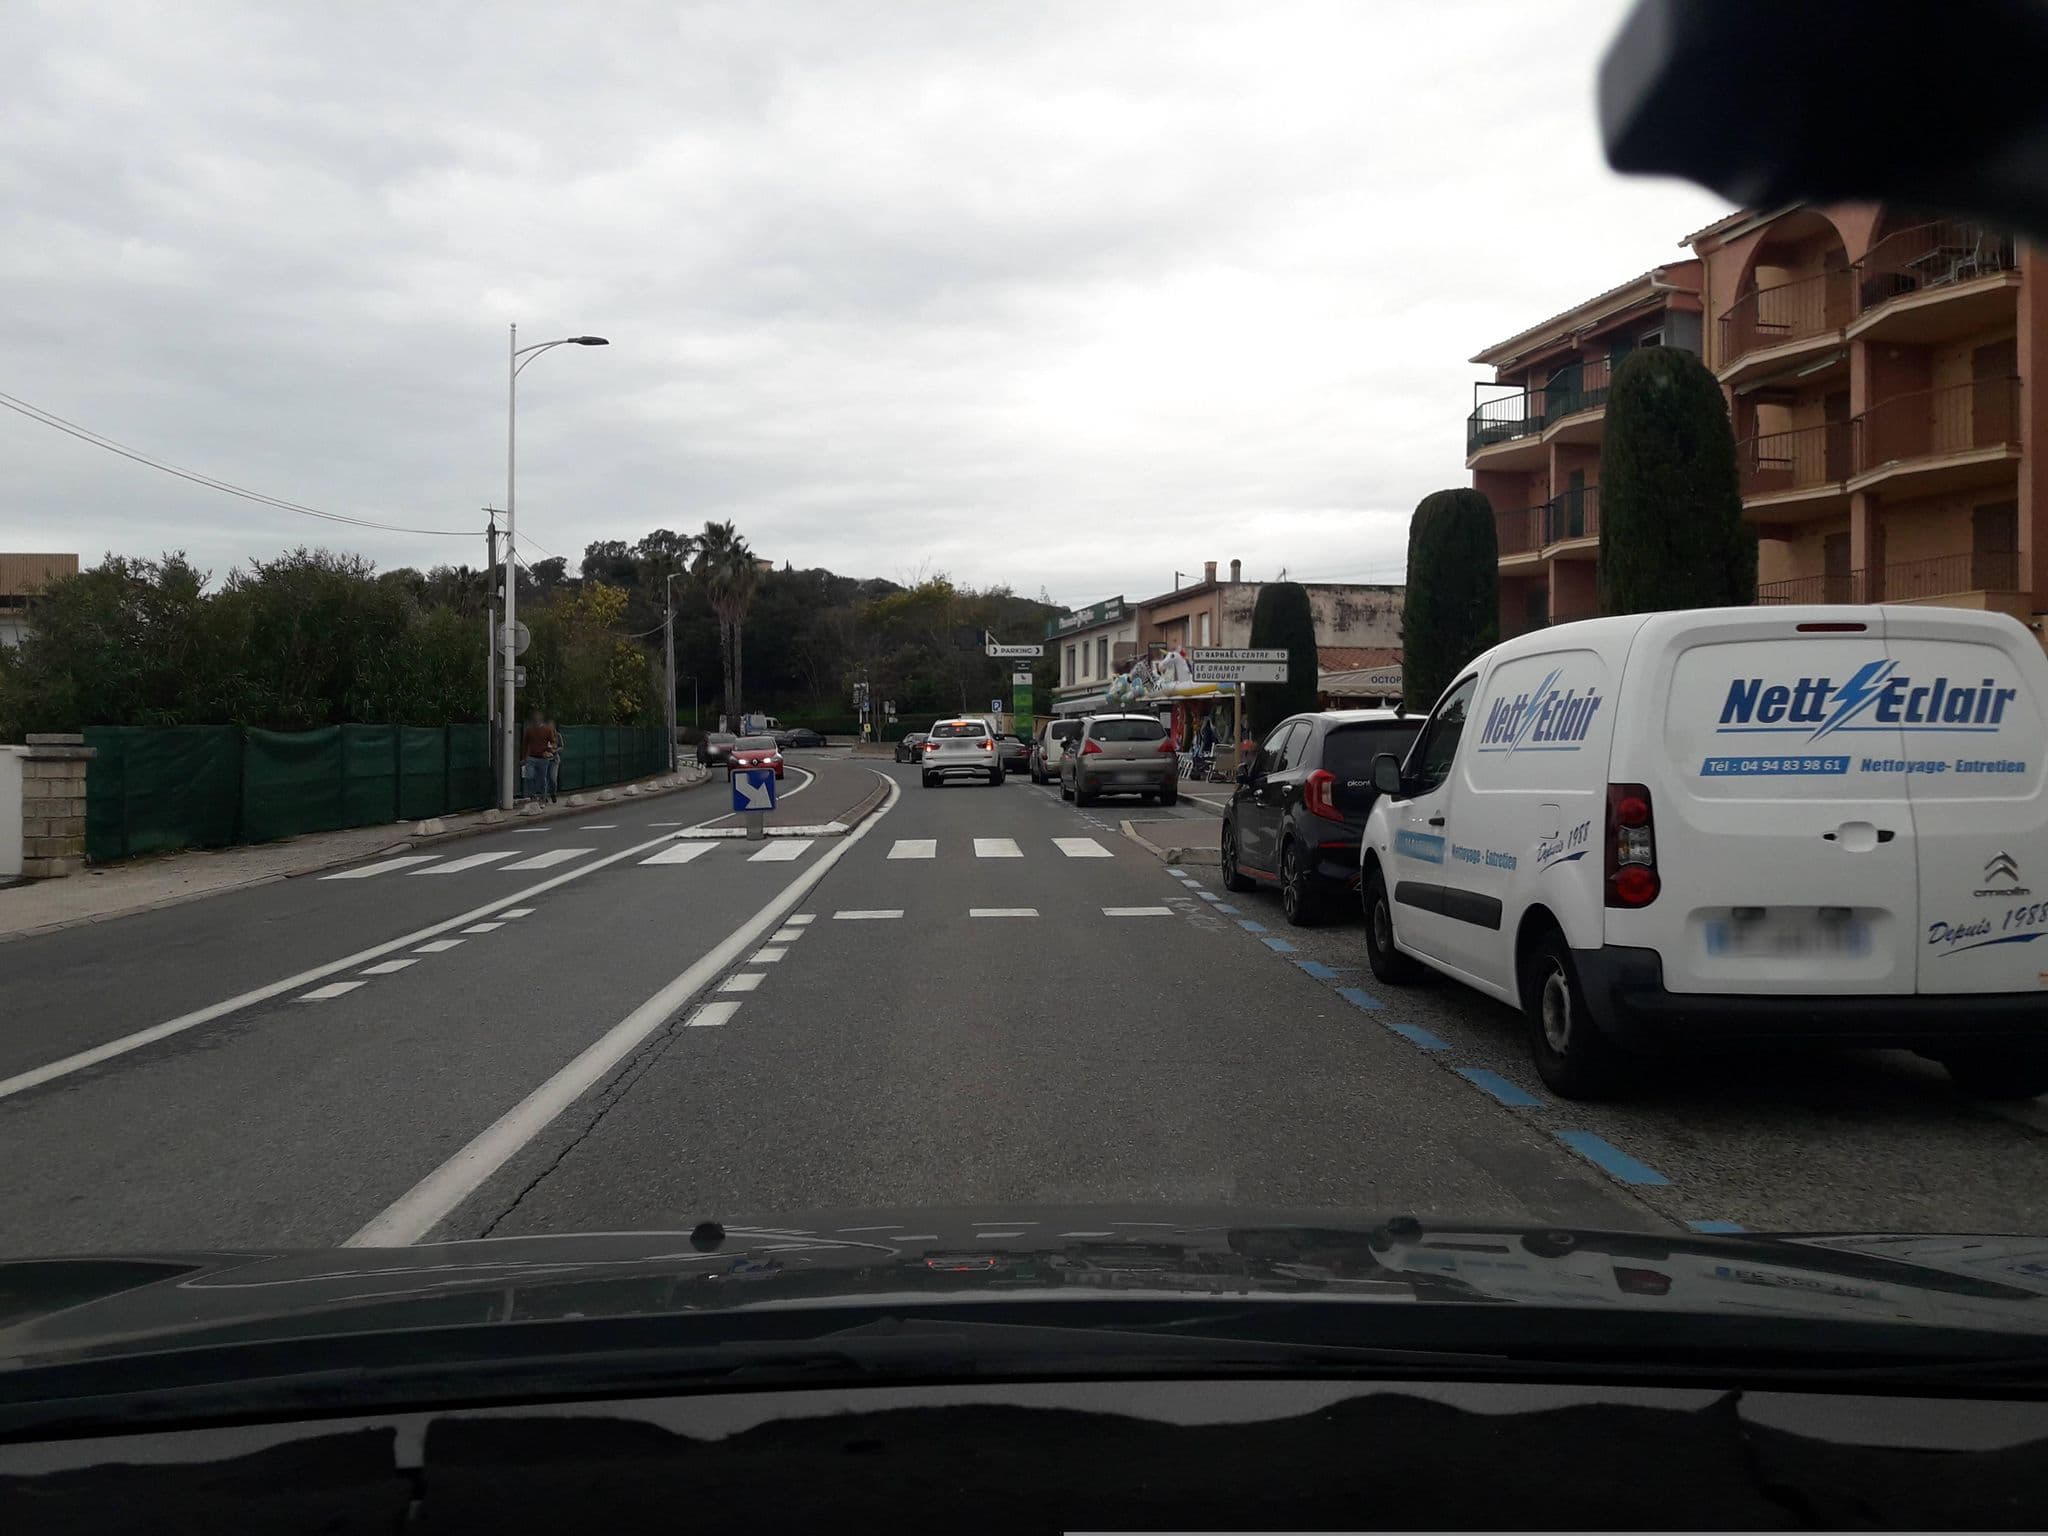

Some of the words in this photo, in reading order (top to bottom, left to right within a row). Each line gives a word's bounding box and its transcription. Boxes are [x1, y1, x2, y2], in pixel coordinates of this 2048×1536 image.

[1208, 664, 1246, 672] DRAMONT
[1196, 672, 1239, 680] BOULOURIS
[1371, 675, 1402, 684] OCTOP
[1719, 677, 1840, 724] Nett
[1875, 677, 2017, 725] Eclair
[1480, 693, 1529, 744] Nett
[1532, 687, 1603, 742] Eclair
[1740, 760, 1758, 772] 04
[1761, 760, 1779, 771] 94
[1782, 760, 1799, 771] 83
[1803, 760, 1820, 771] 98
[1823, 760, 1841, 771] 61
[1955, 759, 2026, 773] Entretien
[1568, 820, 1592, 850] 1988
[1928, 918, 1992, 947] Depuis
